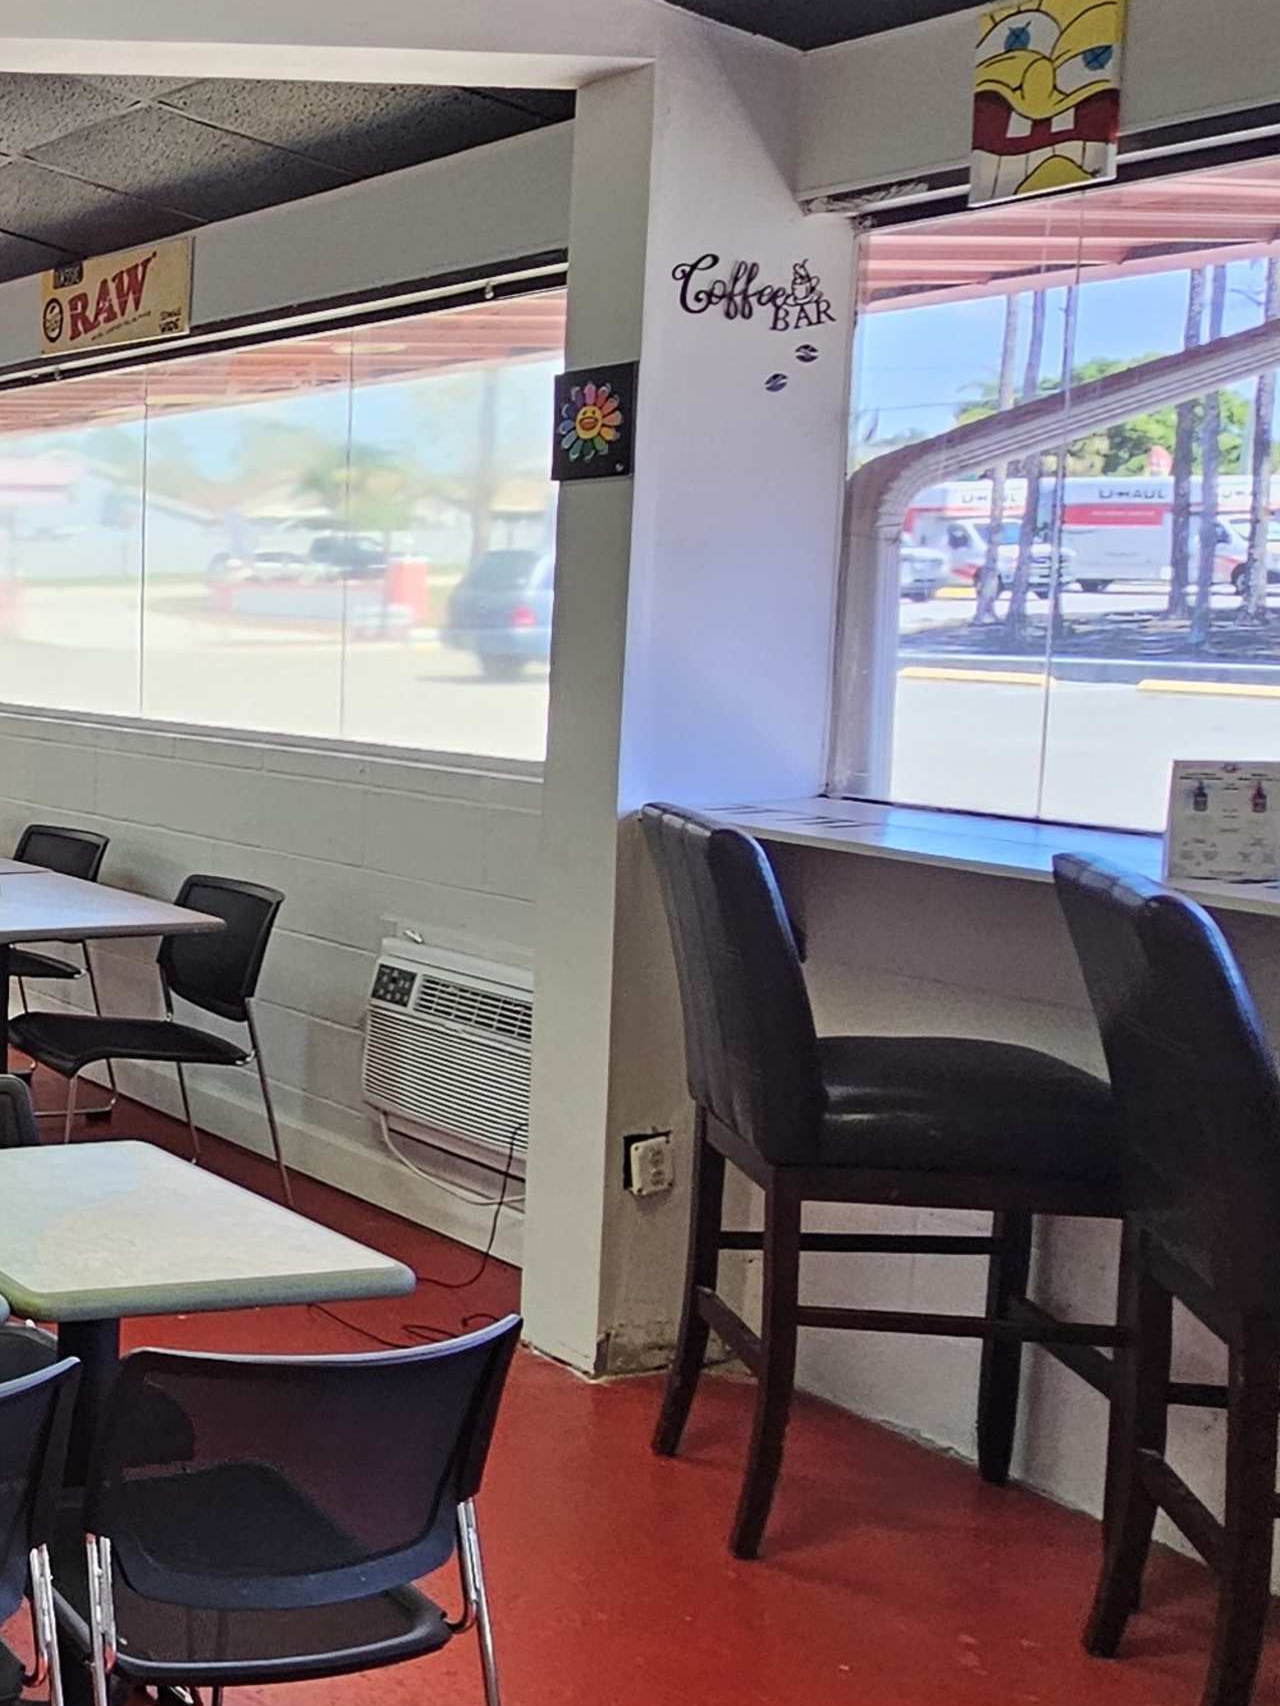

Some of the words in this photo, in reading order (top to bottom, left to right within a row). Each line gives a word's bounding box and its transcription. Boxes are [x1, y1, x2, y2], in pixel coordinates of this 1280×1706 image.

[67, 257, 153, 341] RAW
[671, 253, 787, 320] Coffee
[769, 298, 837, 332] BAR
